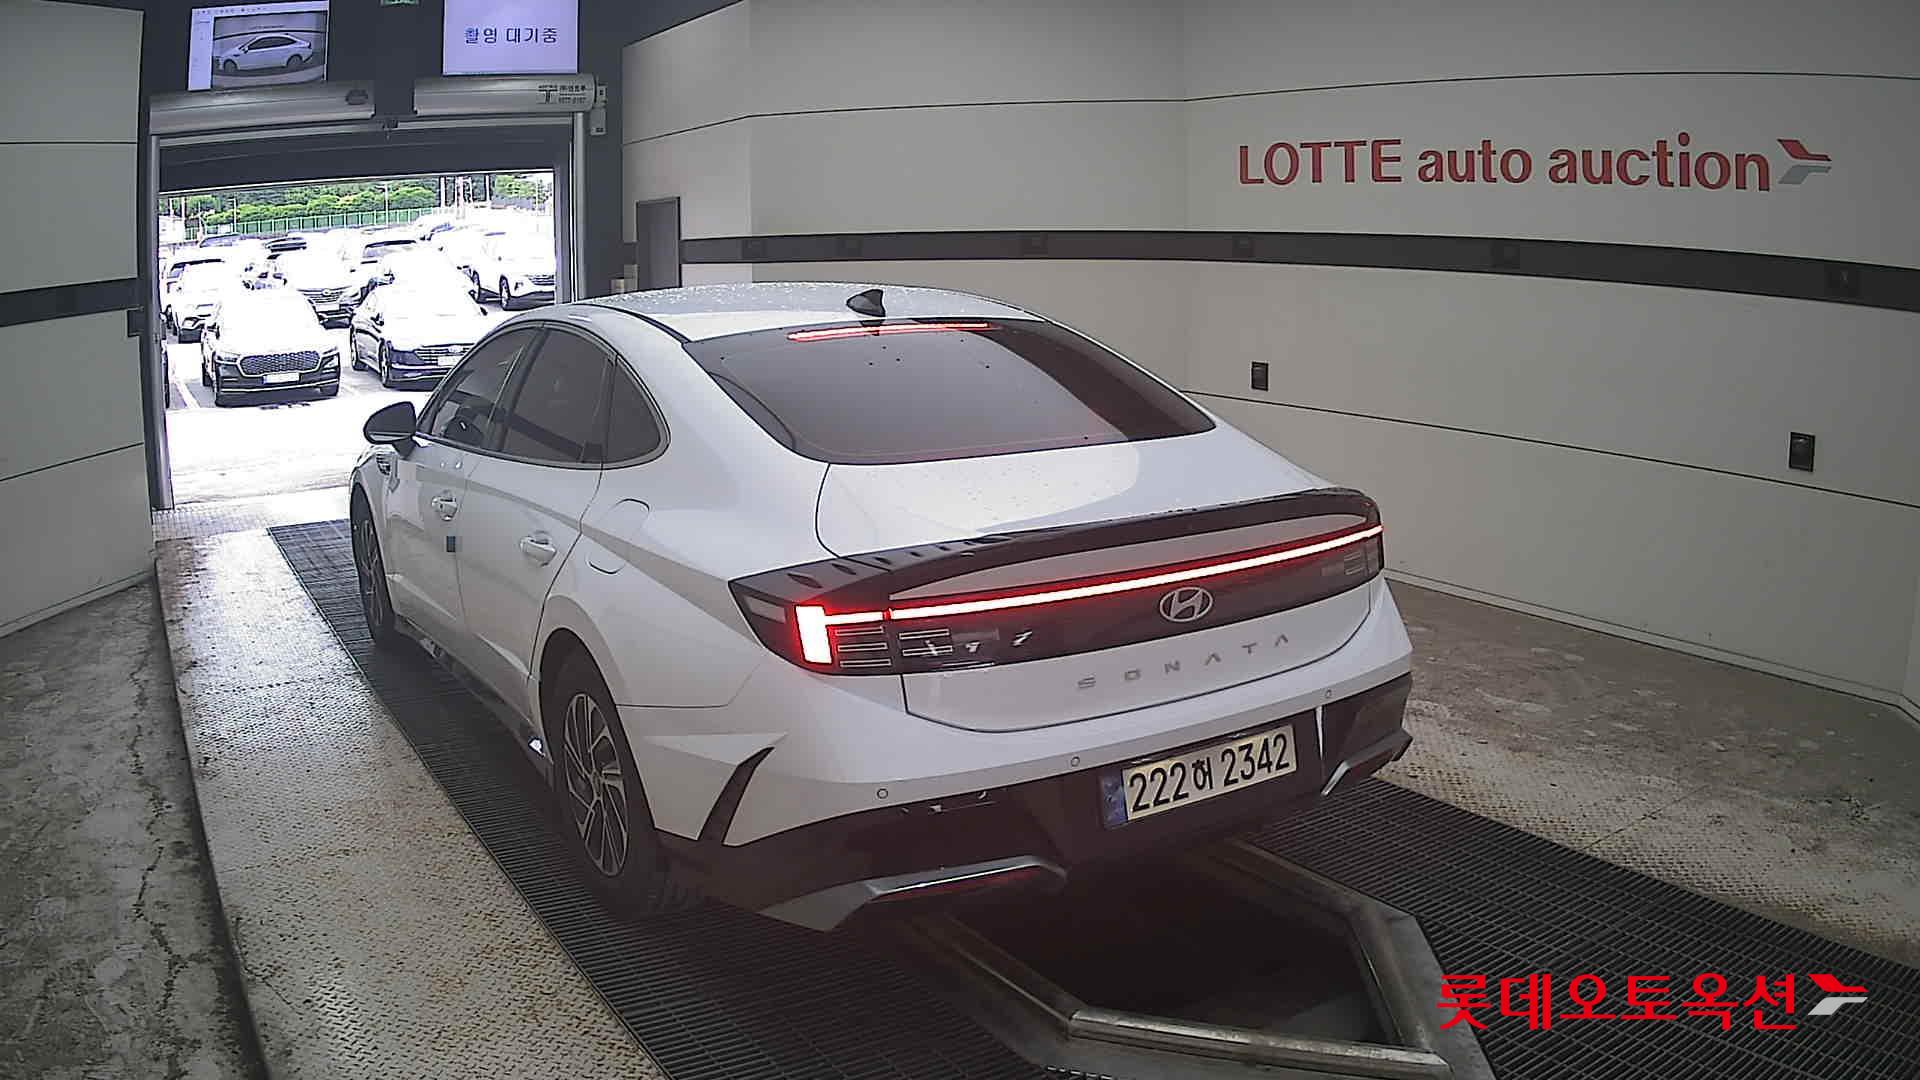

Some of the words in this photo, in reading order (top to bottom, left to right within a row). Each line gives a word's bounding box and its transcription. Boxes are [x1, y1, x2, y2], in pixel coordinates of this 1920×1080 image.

[506, 27, 558, 44] 대기중
[1239, 138, 1402, 186] LOTTE
[1417, 139, 1533, 184] auto
[1548, 131, 1771, 192] auction
[1077, 633, 1289, 690] SONATA
[1128, 756, 1214, 813] 222허
[1220, 733, 1290, 787] 2342
